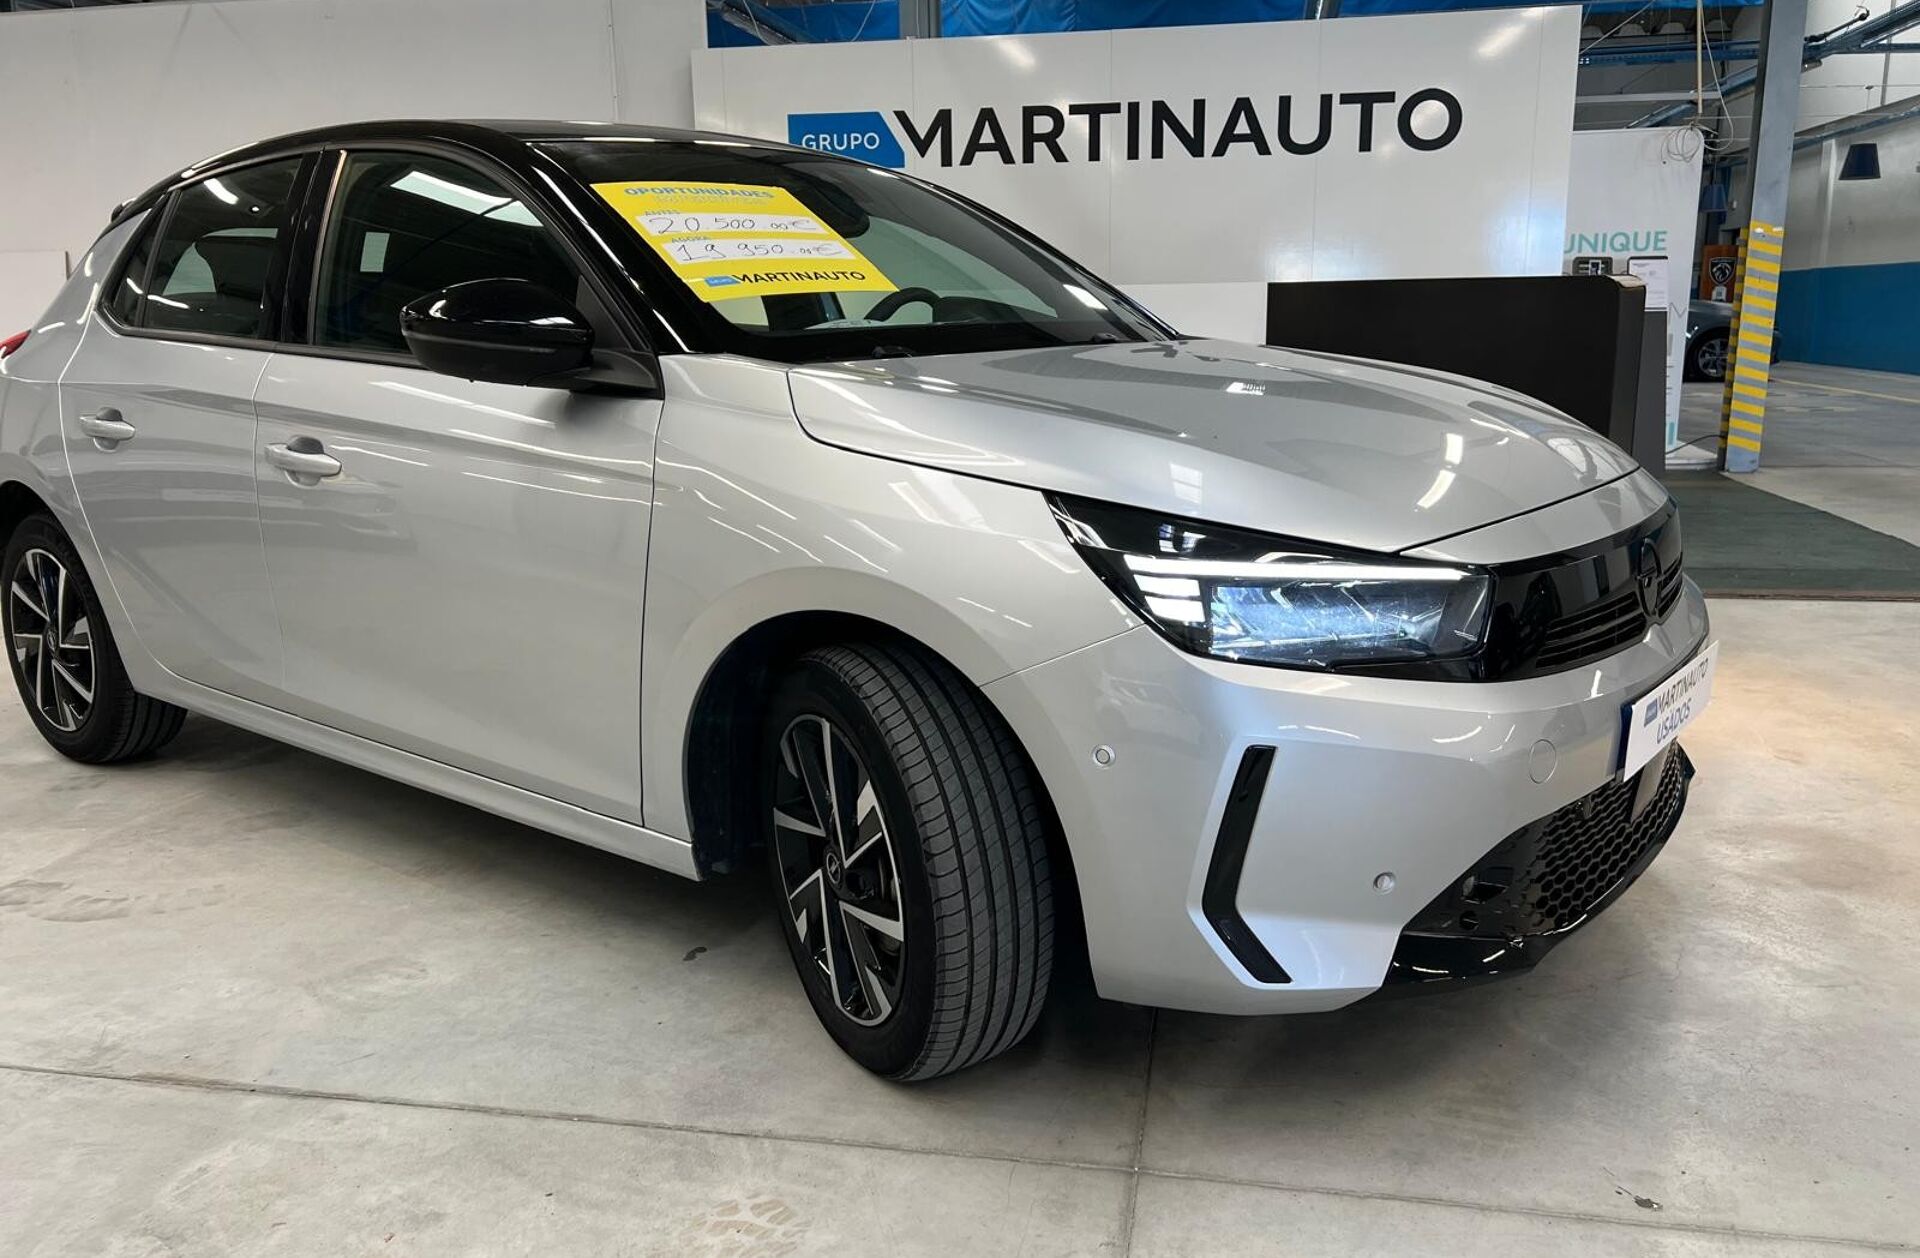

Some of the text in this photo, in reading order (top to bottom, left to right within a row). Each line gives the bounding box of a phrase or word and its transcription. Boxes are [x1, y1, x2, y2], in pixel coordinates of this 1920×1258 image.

[802, 87, 1463, 168] GRUPO MARTINAUTO
[624, 187, 775, 198] OPORTUNIDADES
[732, 270, 866, 284] MARTINAUTO
[1658, 657, 1709, 714] MARTINAUTO
[1656, 698, 1692, 745] USADOS
